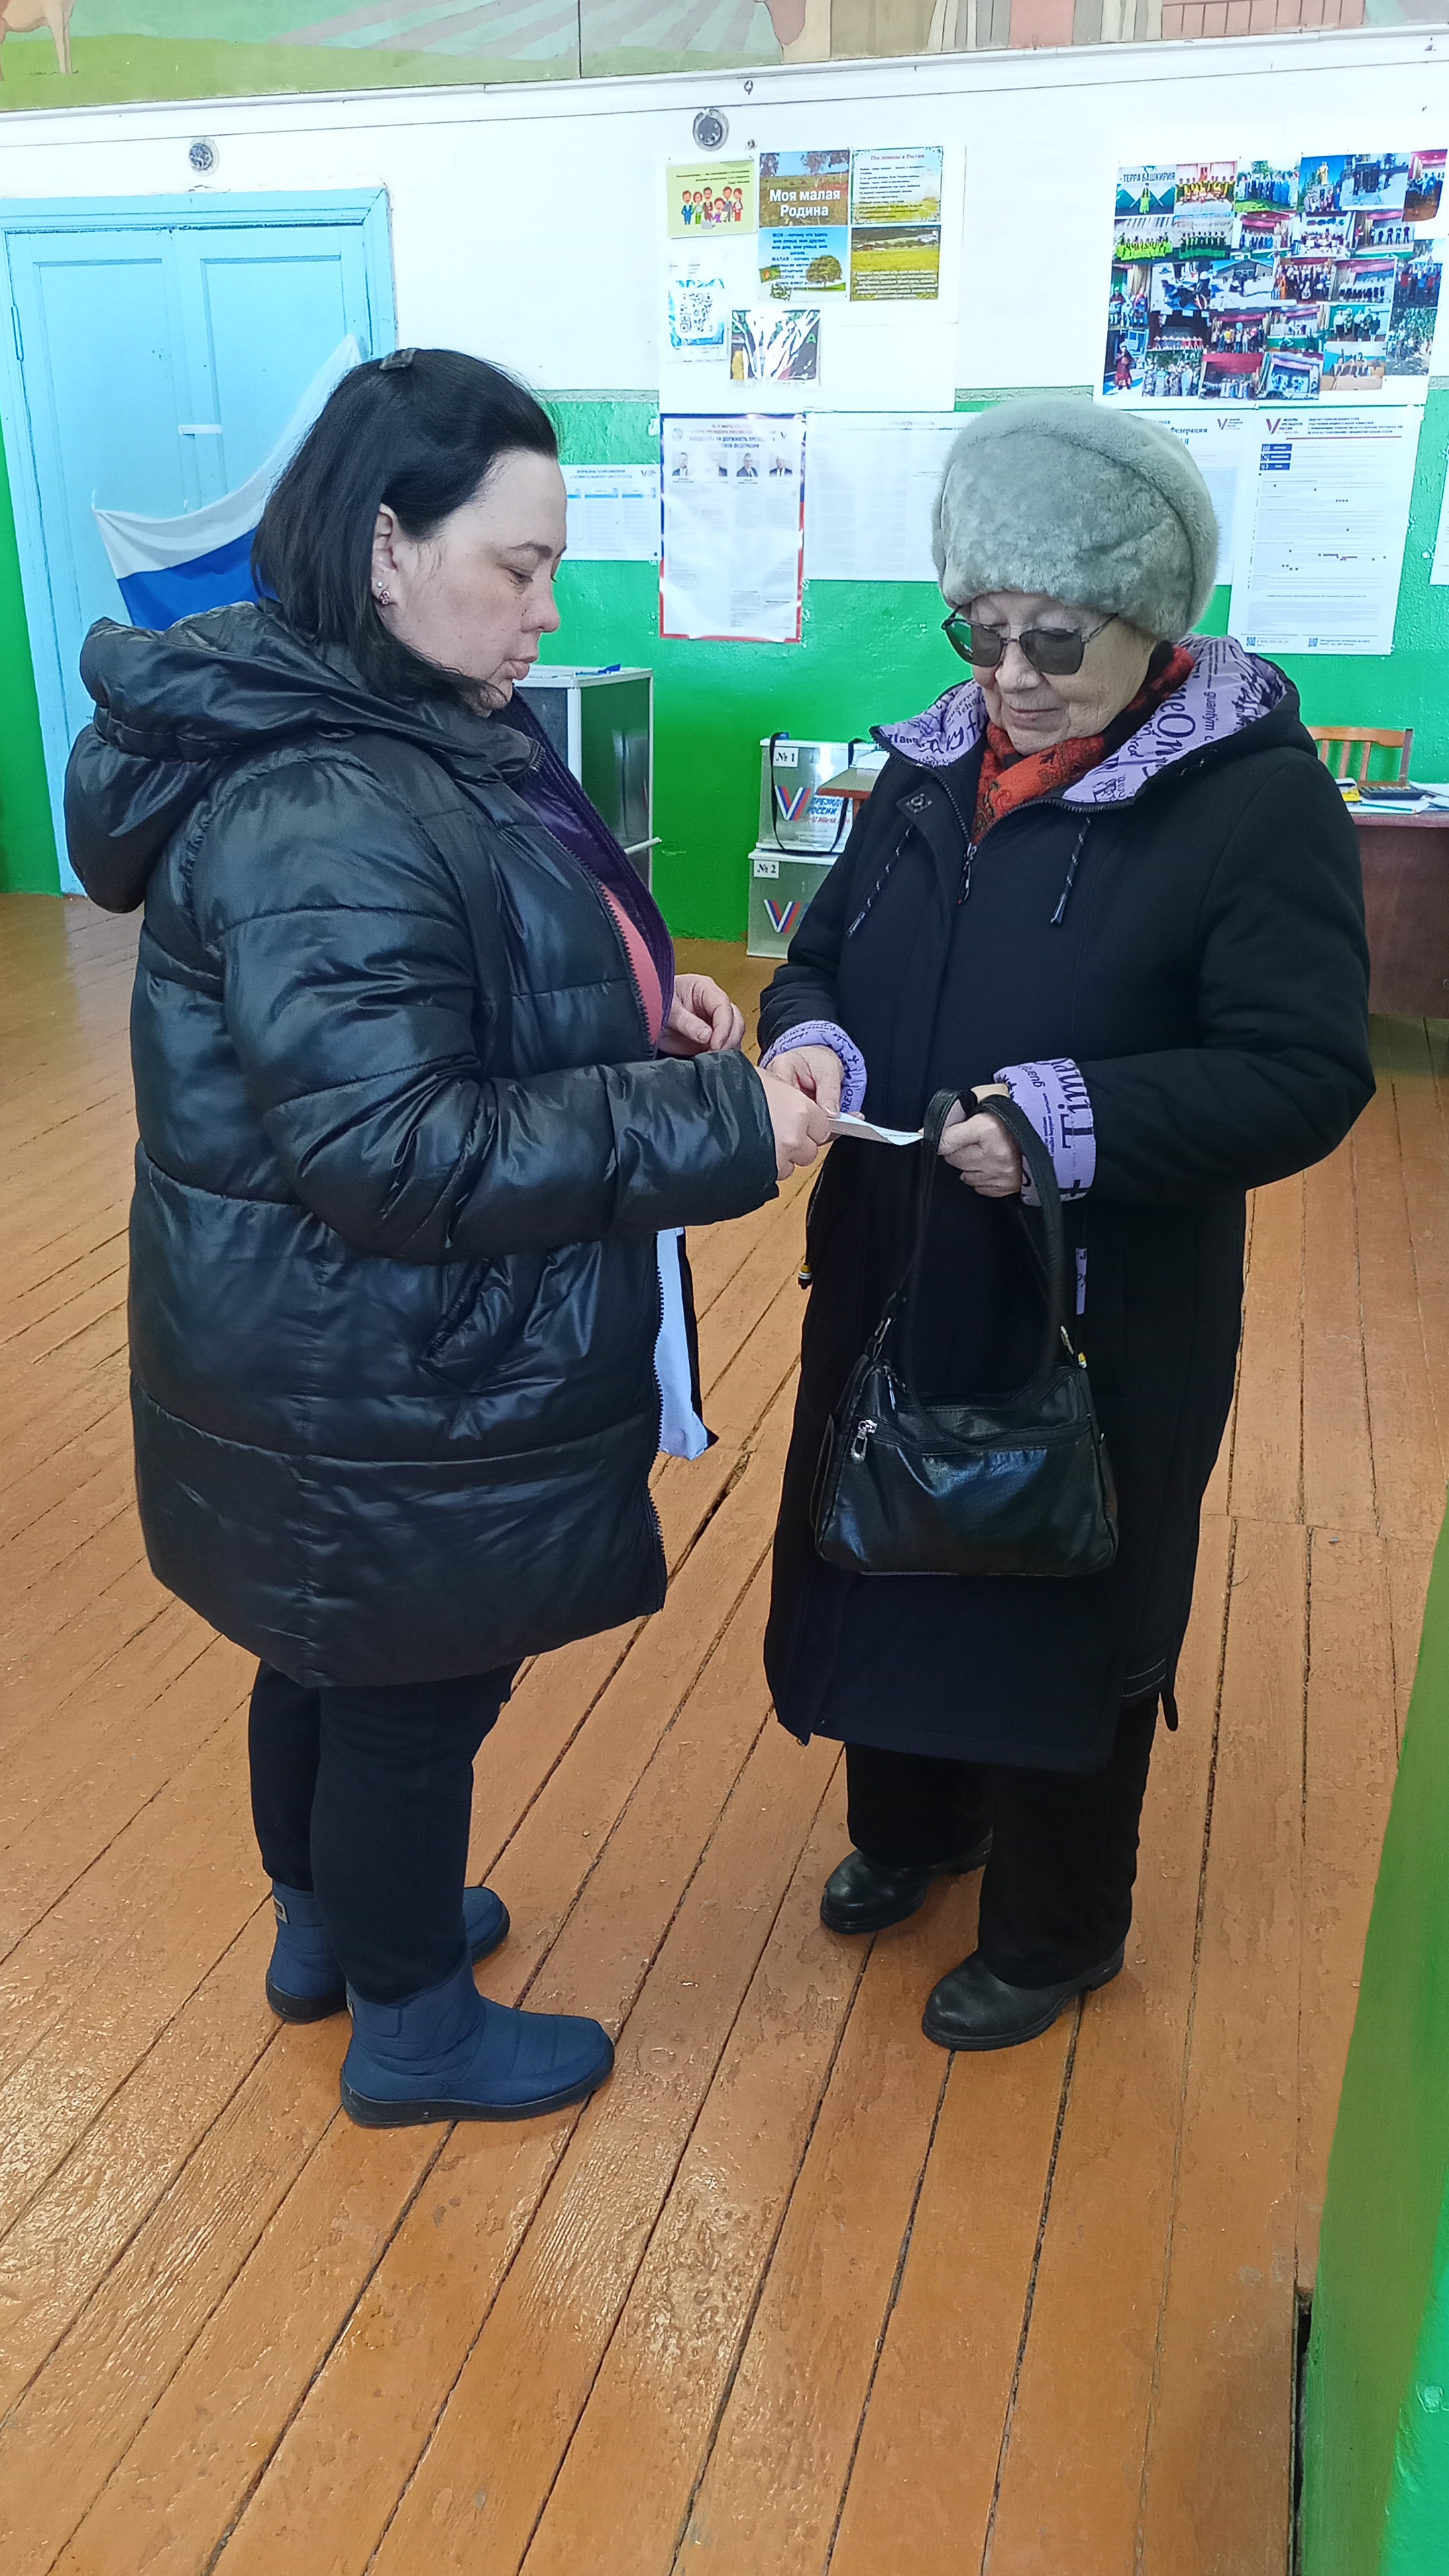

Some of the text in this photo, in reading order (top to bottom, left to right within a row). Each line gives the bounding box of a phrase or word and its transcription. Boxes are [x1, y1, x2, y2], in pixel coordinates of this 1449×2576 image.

[1123, 173, 1140, 182] ТЕРРА
[769, 189, 841, 202] Моя малая
[780, 204, 829, 219] Родина
[775, 752, 796, 763] № 1
[806, 806, 838, 816] РОССИИ
[757, 863, 777, 873] № 2
